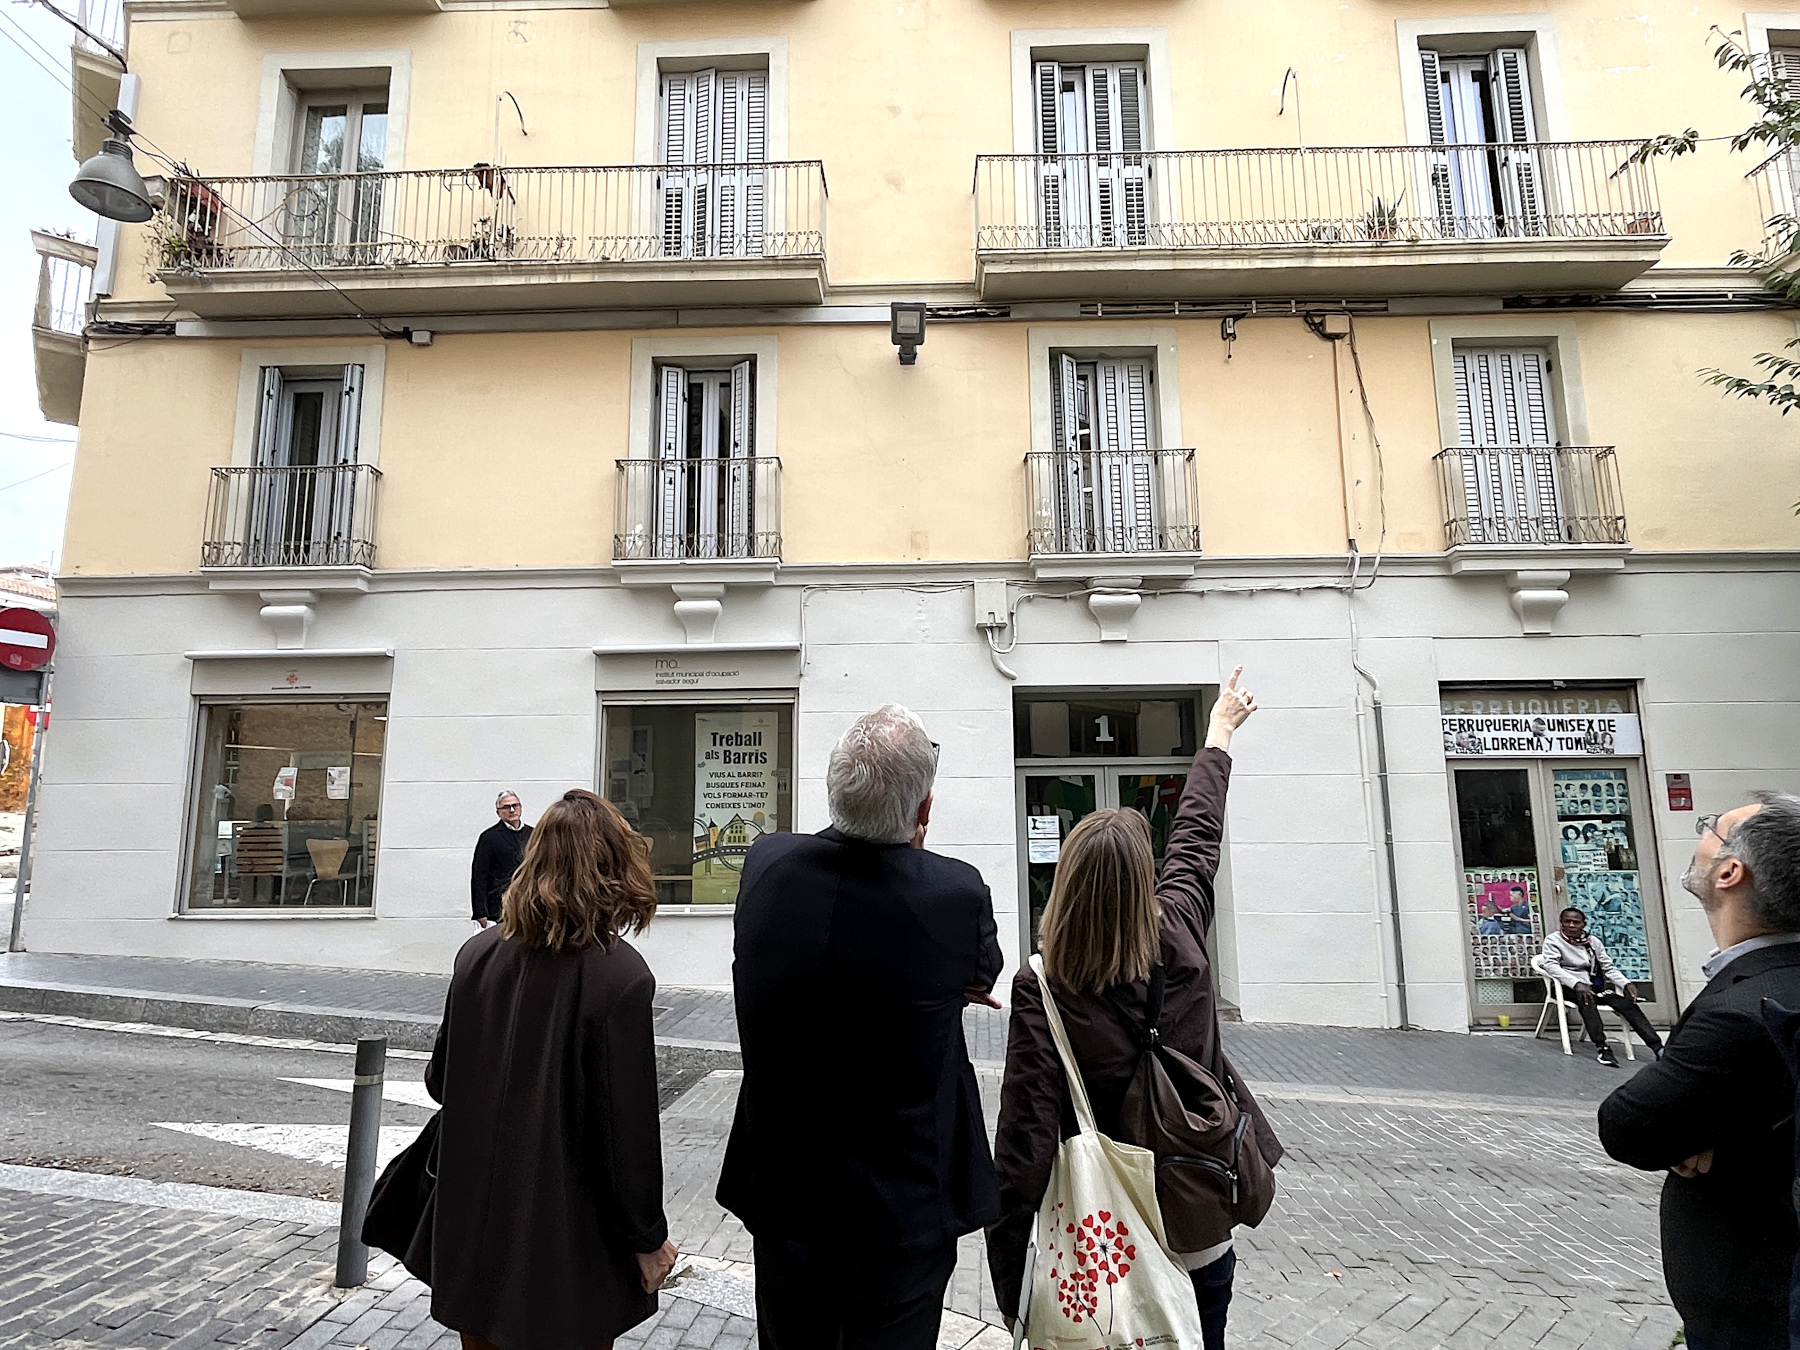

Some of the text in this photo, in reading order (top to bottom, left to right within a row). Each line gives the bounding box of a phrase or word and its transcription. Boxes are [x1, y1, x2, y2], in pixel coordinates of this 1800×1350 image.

[1095, 715, 1114, 741] 1
[1546, 718, 1595, 733] UNISEX
[1598, 719, 1616, 733] DE
[711, 731, 762, 747] Treball
[705, 749, 768, 765] als Barris
